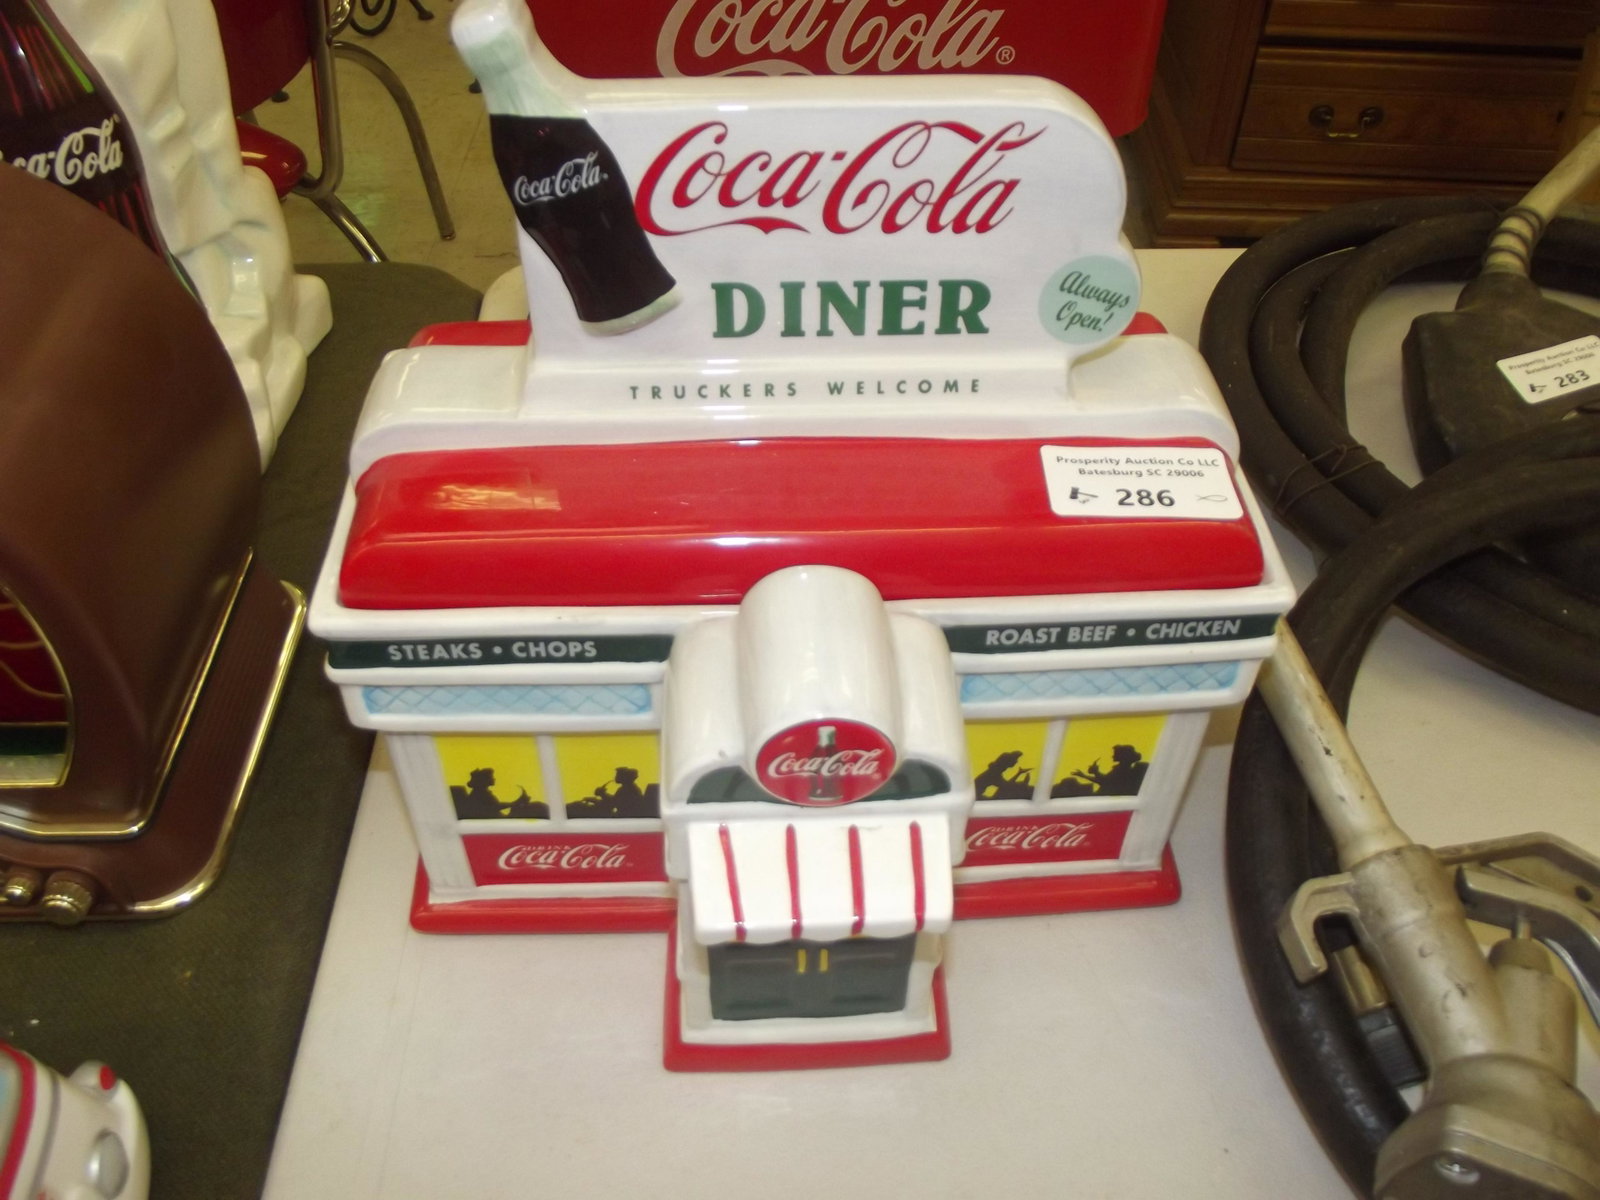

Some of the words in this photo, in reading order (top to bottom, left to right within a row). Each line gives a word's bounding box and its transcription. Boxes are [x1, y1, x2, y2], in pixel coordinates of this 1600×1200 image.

[656, 0, 1004, 77] CocaCola
[514, 150, 600, 206] Coca-Cola
[634, 120, 1048, 237] Coca-Cola
[1059, 270, 1131, 312] Always
[711, 278, 992, 338] DINER
[1056, 300, 1114, 332] Open!
[630, 382, 797, 400] TRUCKERS
[827, 379, 980, 396] WELCOME
[1553, 370, 1590, 388] 283
[1056, 455, 1121, 466] Prosperity
[1125, 457, 1174, 466] Auction
[1178, 457, 1194, 467] Co
[1198, 458, 1220, 468] LLC
[1078, 468, 1143, 478] Batesburg
[1147, 468, 1163, 477] SC
[1166, 469, 1205, 478] 29006
[1116, 488, 1176, 507] 286
[985, 627, 1061, 646] ROAST
[1066, 625, 1117, 643] BEEF
[1145, 619, 1242, 640] CHICKEN
[387, 642, 483, 661] STEAKS
[511, 640, 597, 658] CHOPS
[768, 748, 885, 778] Coca-Cola
[498, 843, 630, 870] Coca-Cola
